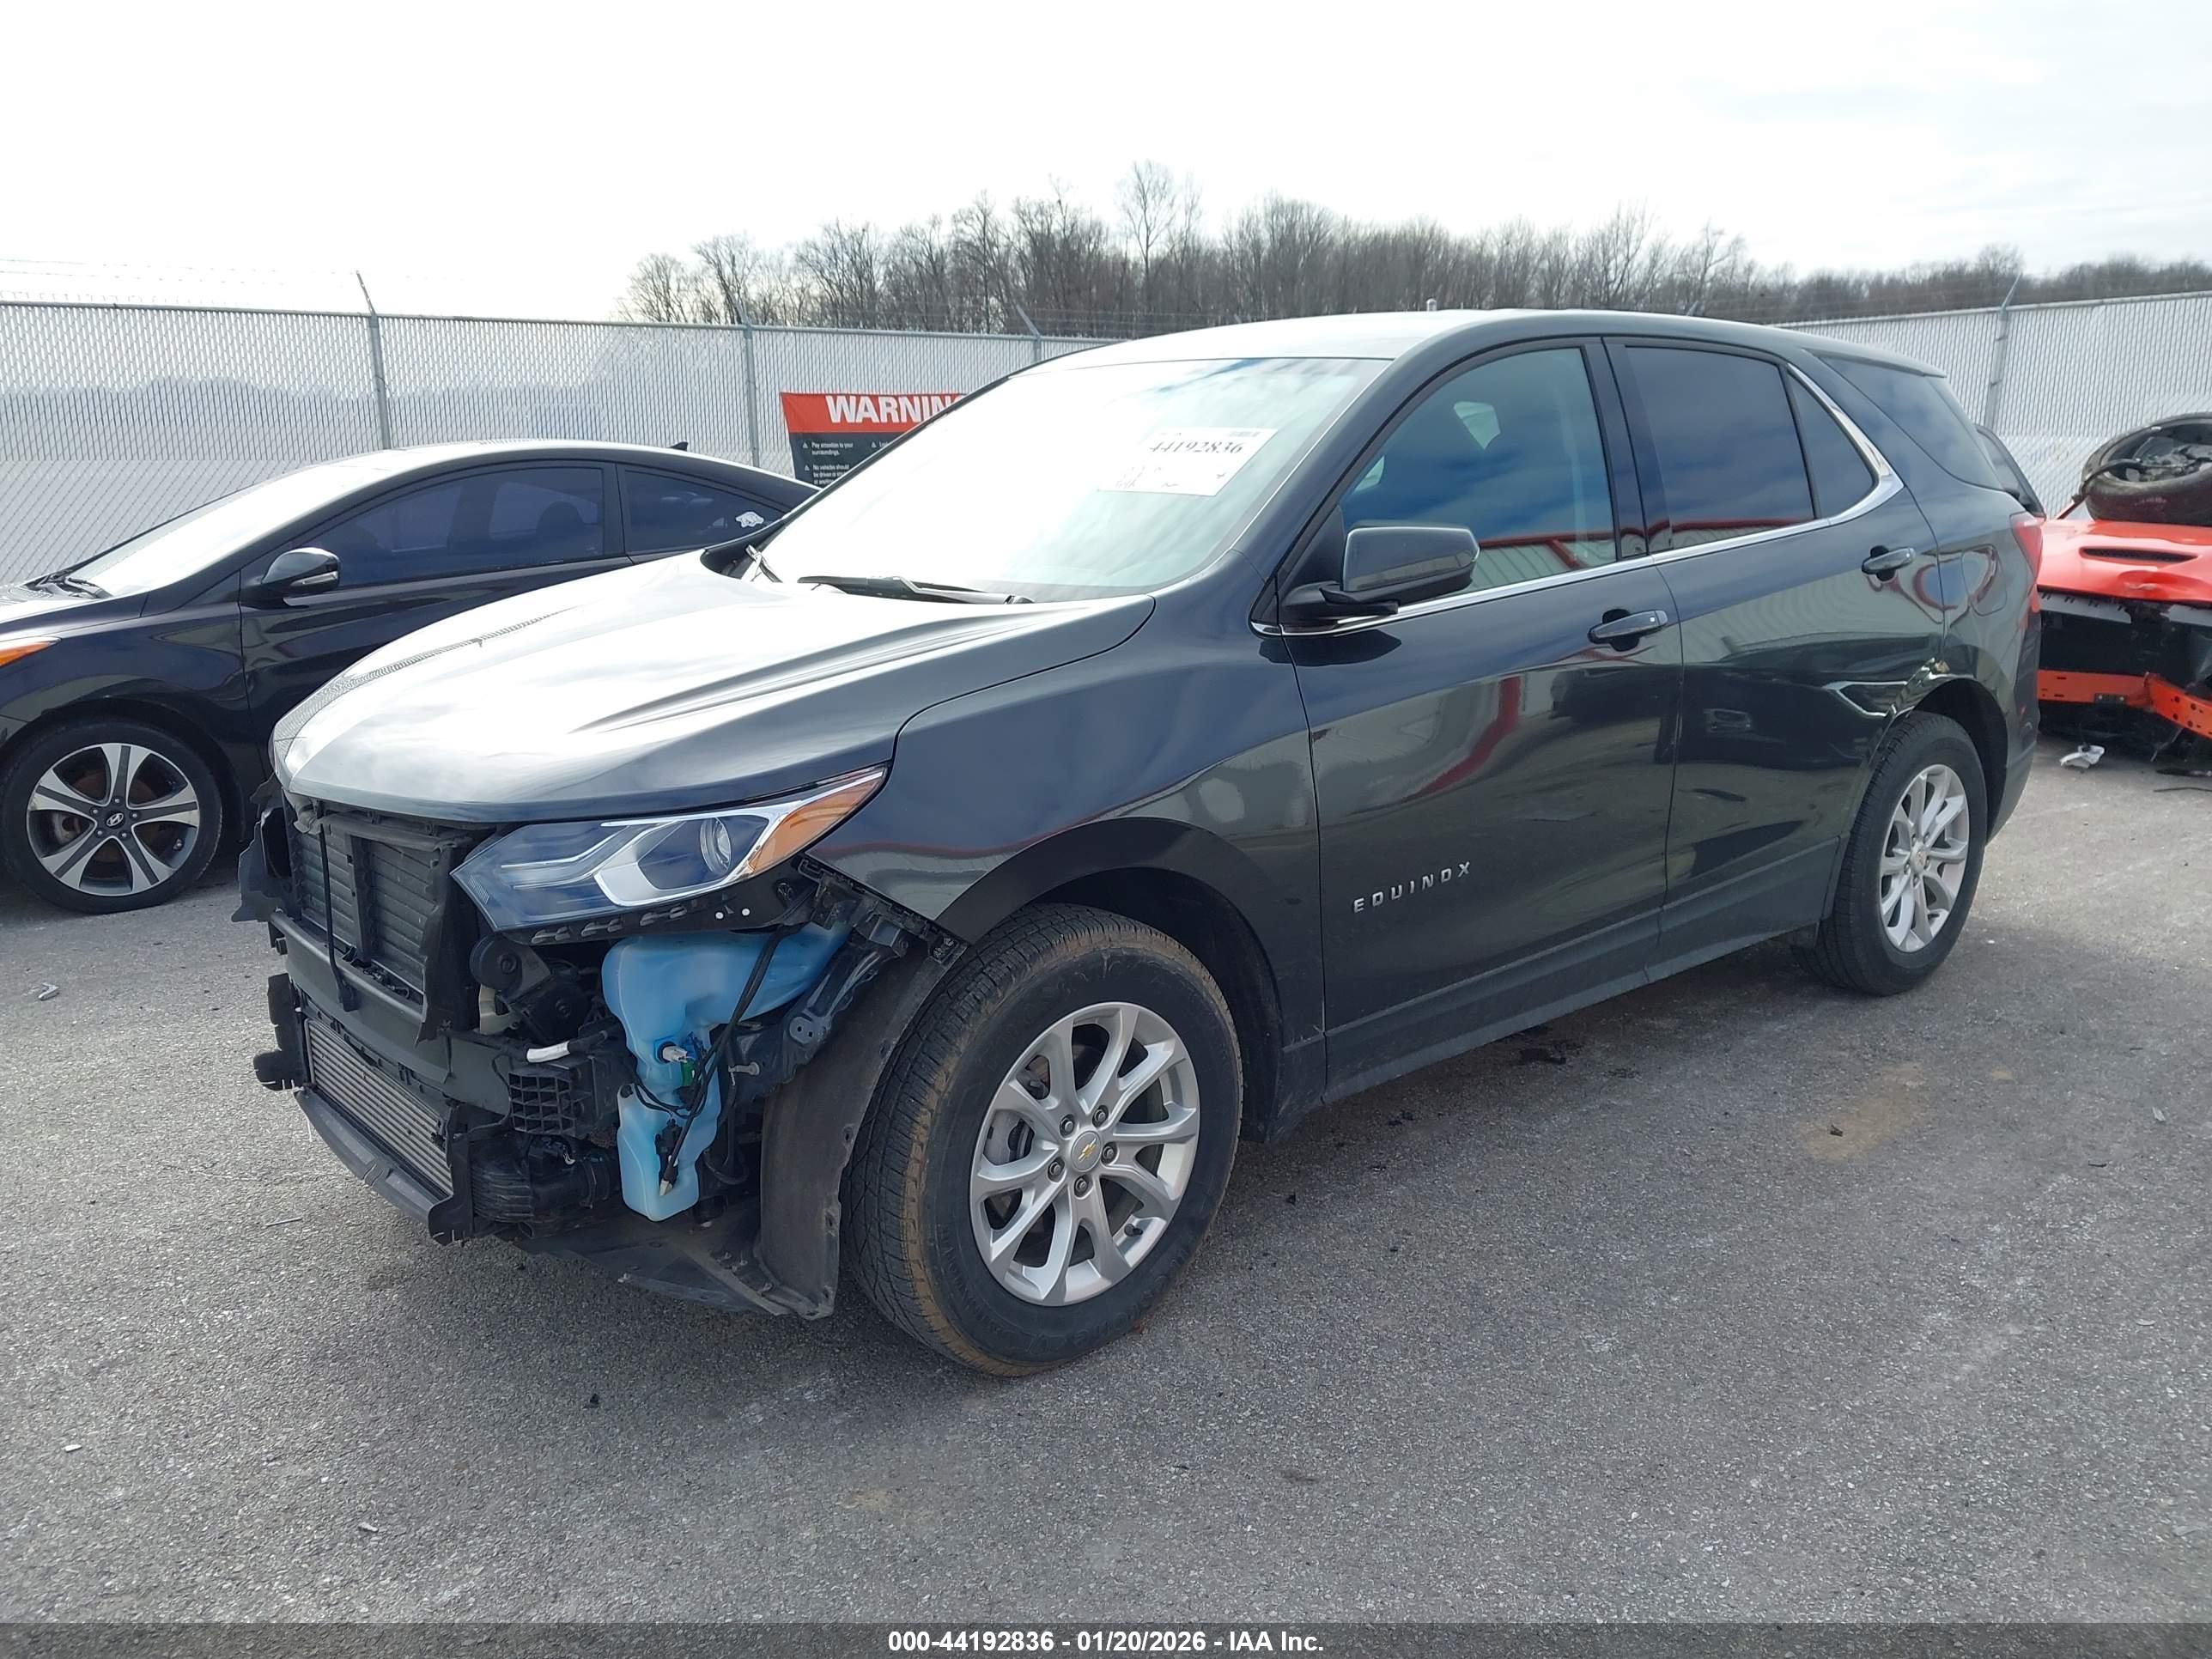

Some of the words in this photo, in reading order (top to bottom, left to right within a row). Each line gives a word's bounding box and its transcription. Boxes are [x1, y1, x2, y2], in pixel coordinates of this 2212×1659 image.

[825, 395, 963, 423] WARNIN
[1149, 441, 1245, 453] 44192836
[1353, 861, 1470, 913] EQUINOX
